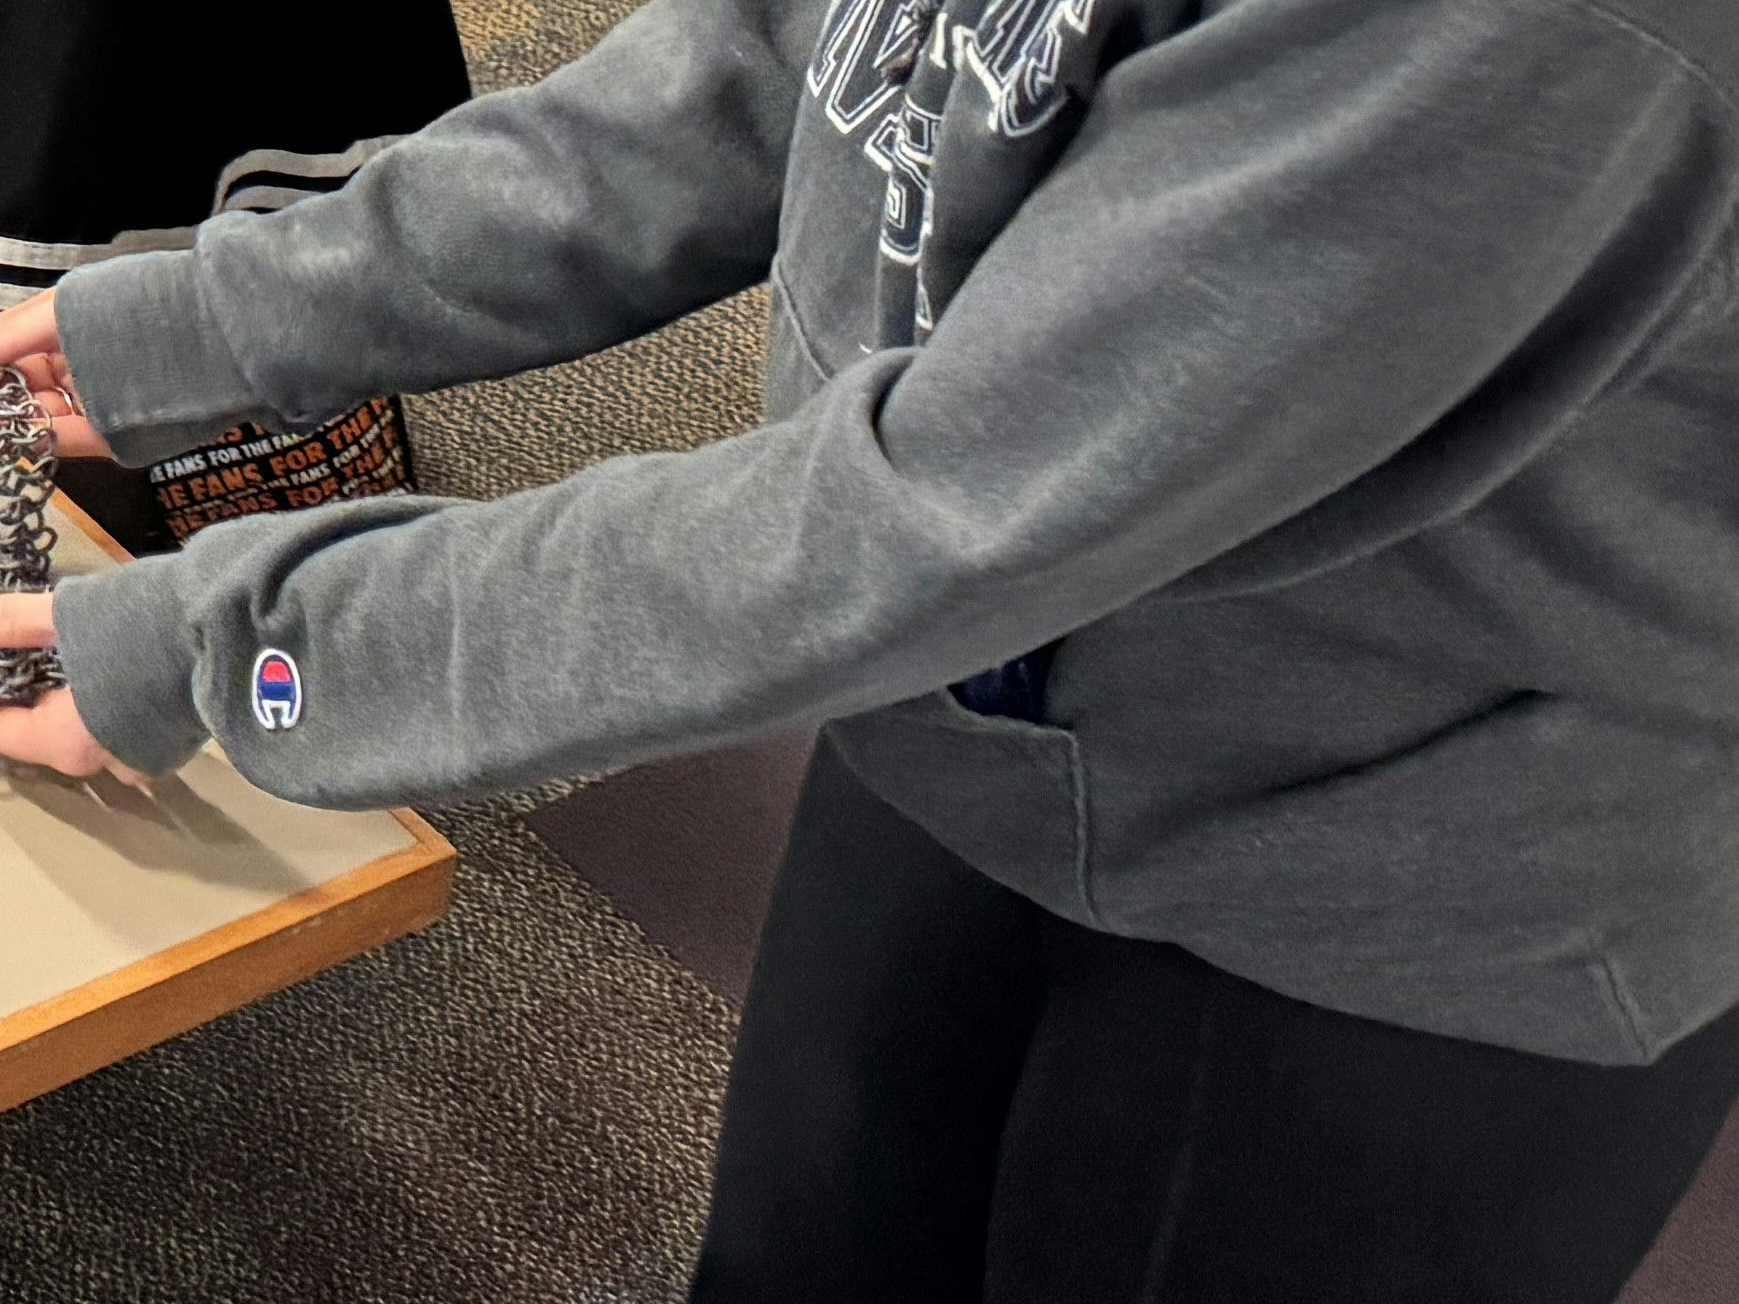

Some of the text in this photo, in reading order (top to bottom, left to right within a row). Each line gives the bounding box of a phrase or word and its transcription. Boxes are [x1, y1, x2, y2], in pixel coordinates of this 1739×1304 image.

[163, 453, 208, 479] FANS
[207, 447, 242, 466] FOR
[240, 439, 273, 459] THE
[189, 463, 264, 501] FANS
[269, 441, 327, 476] FOR
[327, 406, 372, 449] THE
[290, 463, 331, 485] FANS
[285, 477, 339, 507] FOR
